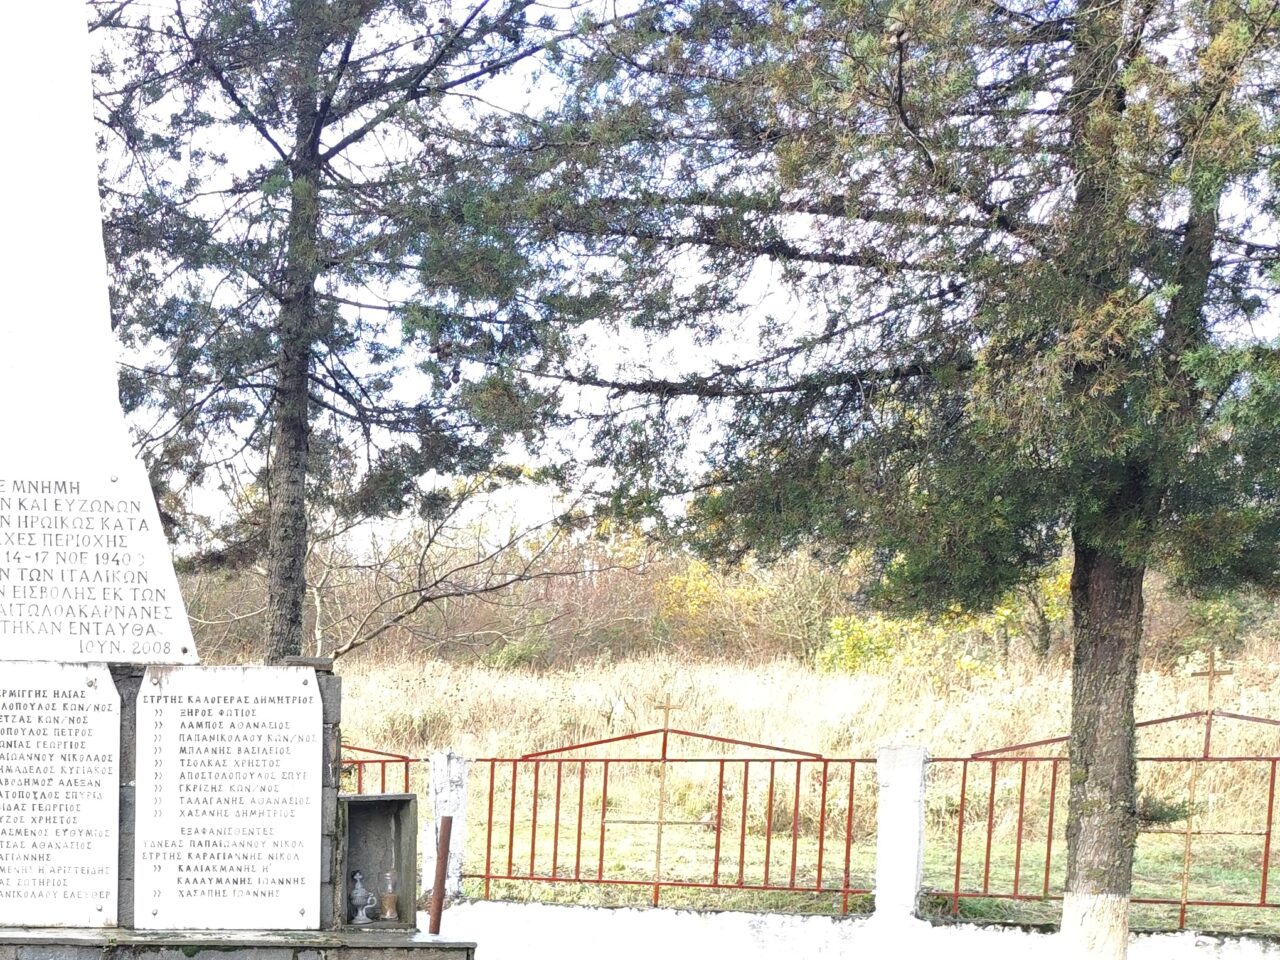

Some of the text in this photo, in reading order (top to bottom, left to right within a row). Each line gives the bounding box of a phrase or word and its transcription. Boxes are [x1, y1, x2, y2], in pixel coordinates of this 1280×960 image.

[12, 480, 80, 494] ΜΝΗΜΗ
[18, 498, 48, 512] ΚΑΙ
[54, 498, 140, 514] ΕΥΖΩΝΩΝ
[18, 516, 94, 530] ΗΡΩΙΚΩΣ
[100, 518, 150, 532] ΚΑΤΑ
[42, 534, 128, 551] ΠΕΡΙΟΧΗΣ
[56, 552, 88, 564] ΝΟΕ
[19, 568, 54, 582] ΤΩΝ
[60, 568, 148, 584] ΙΤΑΛΙΚΩΝ
[12, 586, 96, 600] ΕΙΣΒΟΛΗΣ
[102, 588, 124, 602] ΕΚ
[130, 588, 166, 602] ΤΩΝ
[132, 642, 170, 654] 2008
[52, 690, 86, 698] ΗΛΙΑΣ
[142, 696, 314, 704] ΣΤΡΤΗΣ ΚΑΛΟΓΕΡΑΣ ΔΗΜΗΤΡΙΟΣ
[62, 702, 112, 712] ΚΩΝ/ΝΟΣ
[180, 708, 256, 718] ΞΗΡΟΣ ΦΩΤΙΟΣ
[38, 716, 88, 724] ΚΩΝ/ΝΟΣ
[180, 720, 289, 730] ΛΑΜΠΟΣ ΑΘΑΝΑΣΙΟΣ
[54, 728, 92, 736] ΠΕΤΡΟΣ
[178, 734, 315, 742] ΠΑΠΑΝΙΚΟΛΑΟΥ ΚΩΝ/ΝΟΣ
[36, 740, 86, 750] ΓΕΩΡΓΙΟΣ
[180, 746, 290, 754] ΜΠΛΑΝΗΣ ΒΑΣΙΛΕΙΟΣ
[60, 754, 112, 762] ΝΙΚΟΛΑΟΣ
[180, 758, 280, 768] ΤΣΟΛΚΑΣ ΧΡΗΣΤΟΣ
[180, 772, 275, 780] ΑΠΟΣΤΟΛΟΠΟΥΛΟΣ
[58, 778, 100, 788] ΑΛΕΞΑΝ
[178, 784, 278, 792] ΓΚΡΙΖΗΣ ΚΩΝ/ΝΟΣ
[180, 796, 309, 806] ΤΑΛΑΓΑΝΗΣ ΑΘΑΝΑΣΙΟΣ
[32, 804, 80, 812] ΓΕΩΡΓΙΟΣ
[180, 810, 294, 818] ΧΑΣΑΝΗΣ ΔΗΜΗΤΡΙΟΣ
[30, 816, 78, 824] ΧΡΗΣΤΟΣ
[56, 828, 110, 838] ΕΥΘΥΜΙΟΣ
[180, 828, 274, 836] ΕΞΑΦΑΝΙΣΘΕΝΤΕΣ
[32, 842, 92, 850] ΑΘΑΝΑΣΙΟΣ
[272, 840, 304, 848] ΝΙΚΟΛ
[142, 852, 300, 860] ΣΤΡΤΗΣ ΚΑΡΑΓΙΑΝΝΗΣ ΝΙΚΟΛ
[178, 864, 255, 872] ΚΑΛΙΑΚΜΑΝΗΣ
[18, 878, 67, 886] ΣΩΤΗΡΙΟΣ
[176, 876, 305, 886] ΚΑΛΑΥΜΑΝΗΣ ΙΩΑΝΝΗΣ
[178, 890, 279, 898] ΧΑΣΑΠΗΣ ΙΩΑΝΝΗΣ
